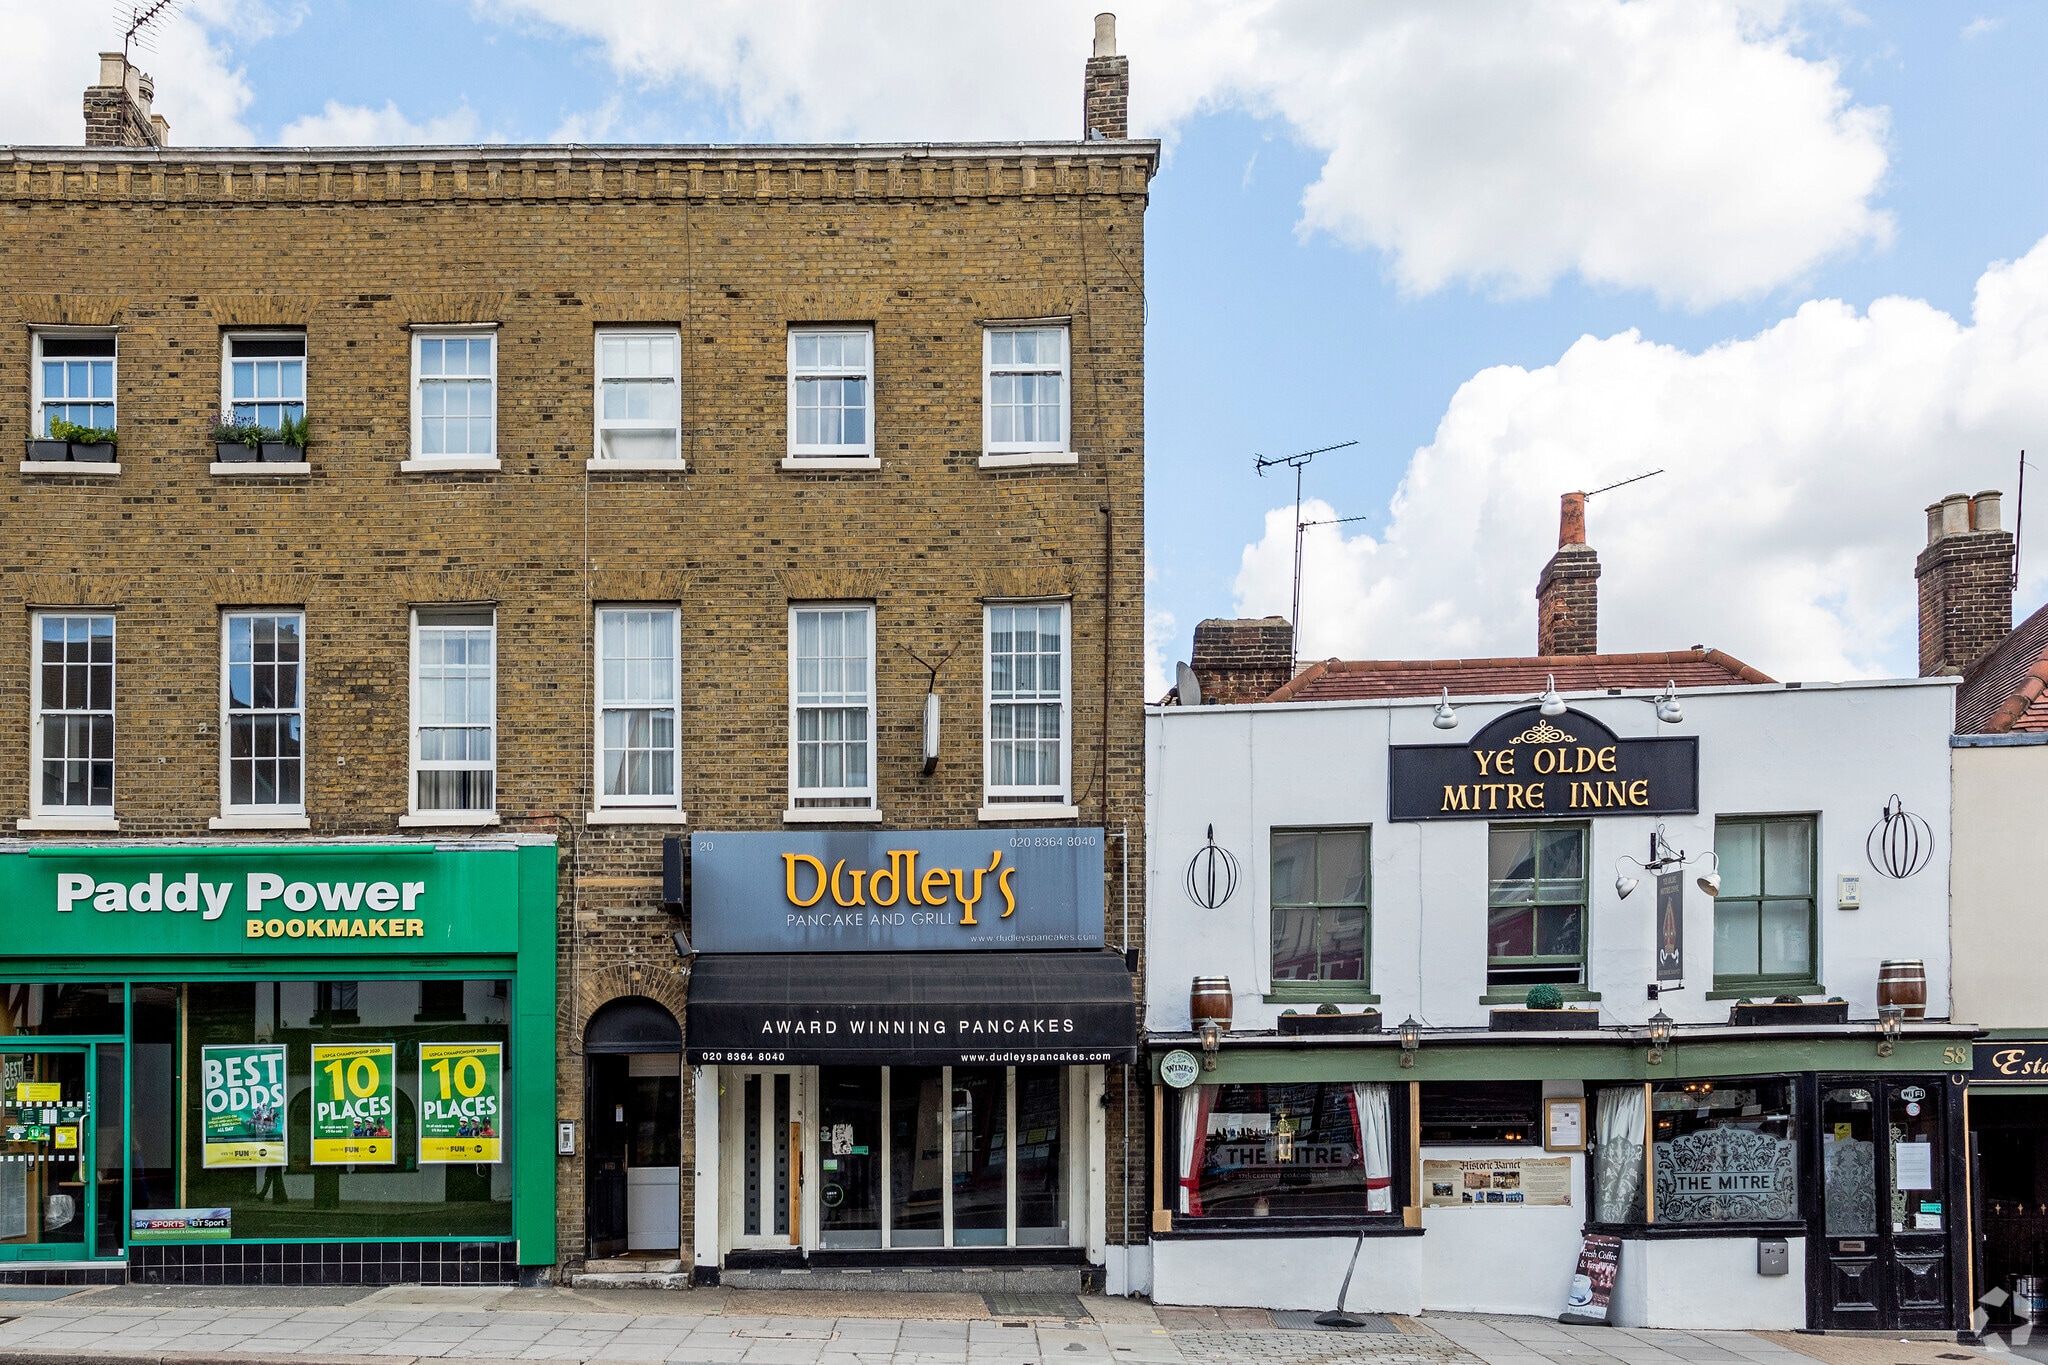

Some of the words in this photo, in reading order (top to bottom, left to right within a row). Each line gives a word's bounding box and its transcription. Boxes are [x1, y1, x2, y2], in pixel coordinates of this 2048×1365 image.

[1474, 749, 1515, 776] YE
[1534, 746, 1617, 774] OLDE
[1440, 782, 1545, 811] MITRE
[1569, 780, 1648, 808] INNE
[700, 842, 714, 851] 20
[1010, 837, 1030, 848] 020
[1034, 837, 1062, 847] 8364
[1067, 836, 1096, 846] 8040
[57, 872, 234, 920] Paddy
[246, 872, 425, 912] Power
[782, 850, 1016, 924] Dudley's
[246, 918, 424, 938] BOOKMAKER
[787, 914, 863, 926] PANCAKE
[870, 913, 904, 926] AND
[912, 912, 954, 926] GRILL
[762, 1020, 838, 1034] AWARD
[850, 1020, 946, 1034] WINNING
[960, 1019, 1074, 1034] PANCAKES
[702, 1052, 722, 1060] 020
[727, 1052, 754, 1060] 8364
[758, 1052, 784, 1060] 8040
[961, 1052, 1110, 1062] www.dudleyspancakes.com
[1943, 1046, 1966, 1064] 58
[5, 1060, 22, 1078] BEST
[205, 1053, 282, 1089] BEST
[1165, 1064, 1194, 1073] WINES
[324, 1056, 380, 1100] 10
[431, 1056, 486, 1100] 10
[206, 1084, 284, 1113] ODDS
[317, 1096, 390, 1121] PLACES
[424, 1096, 497, 1120] PLACES
[1226, 1148, 1267, 1164] THE
[1459, 1161, 1493, 1171] Historic
[1494, 1161, 1521, 1170] Barnet
[1678, 1177, 1712, 1190] THE
[1719, 1175, 1770, 1189] MITRE
[1582, 1249, 1597, 1258] Fresh
[1598, 1250, 1617, 1261] Coffee
